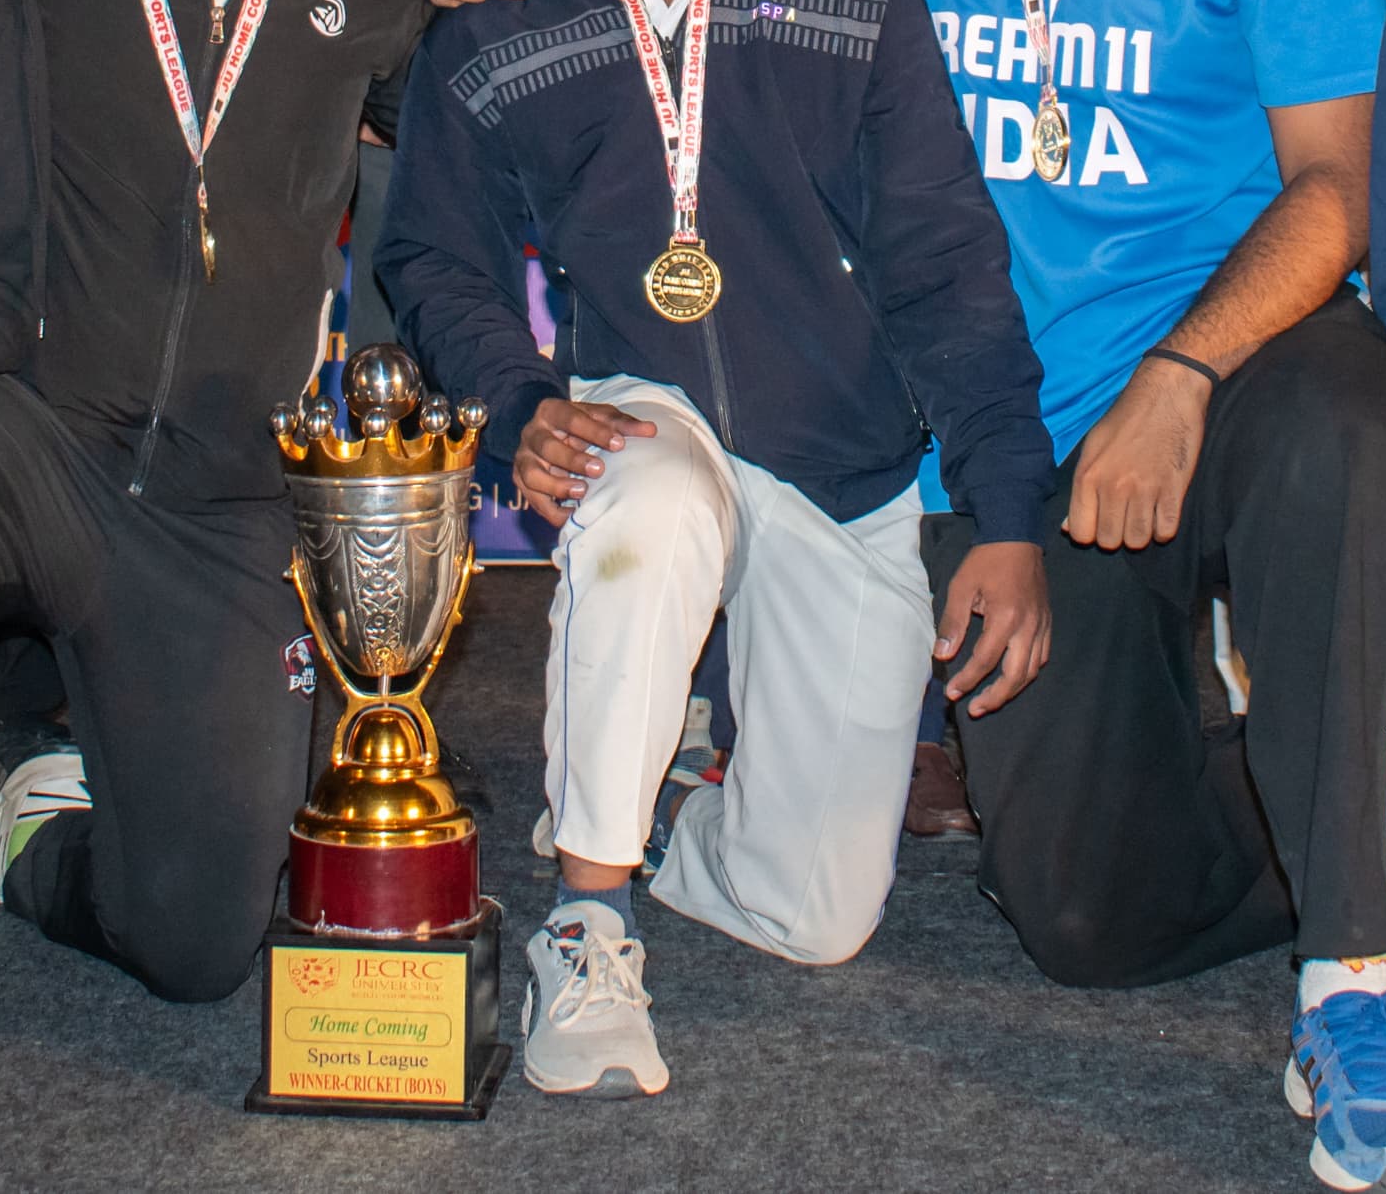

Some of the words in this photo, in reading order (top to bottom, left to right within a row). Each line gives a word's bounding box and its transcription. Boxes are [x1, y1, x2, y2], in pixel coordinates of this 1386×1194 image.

[218, 69, 235, 93] JU
[228, 19, 254, 68] HOME
[686, 23, 703, 87] SPORTS
[931, 11, 1153, 94] REAM11
[163, 46, 190, 113] LEAGUE
[646, 56, 668, 104] HOME
[660, 105, 676, 128] JU
[683, 91, 697, 157] LEAGUE
[352, 979, 443, 993] UNIVERSITY
[354, 958, 444, 980] JECRC
[309, 1014, 359, 1034] Home
[364, 1017, 429, 1042] Coming
[308, 1047, 361, 1068] Sports
[367, 1050, 429, 1072] League
[289, 1072, 400, 1094] WINNER-CRICKET
[405, 1077, 447, 1097] (BOYS)
